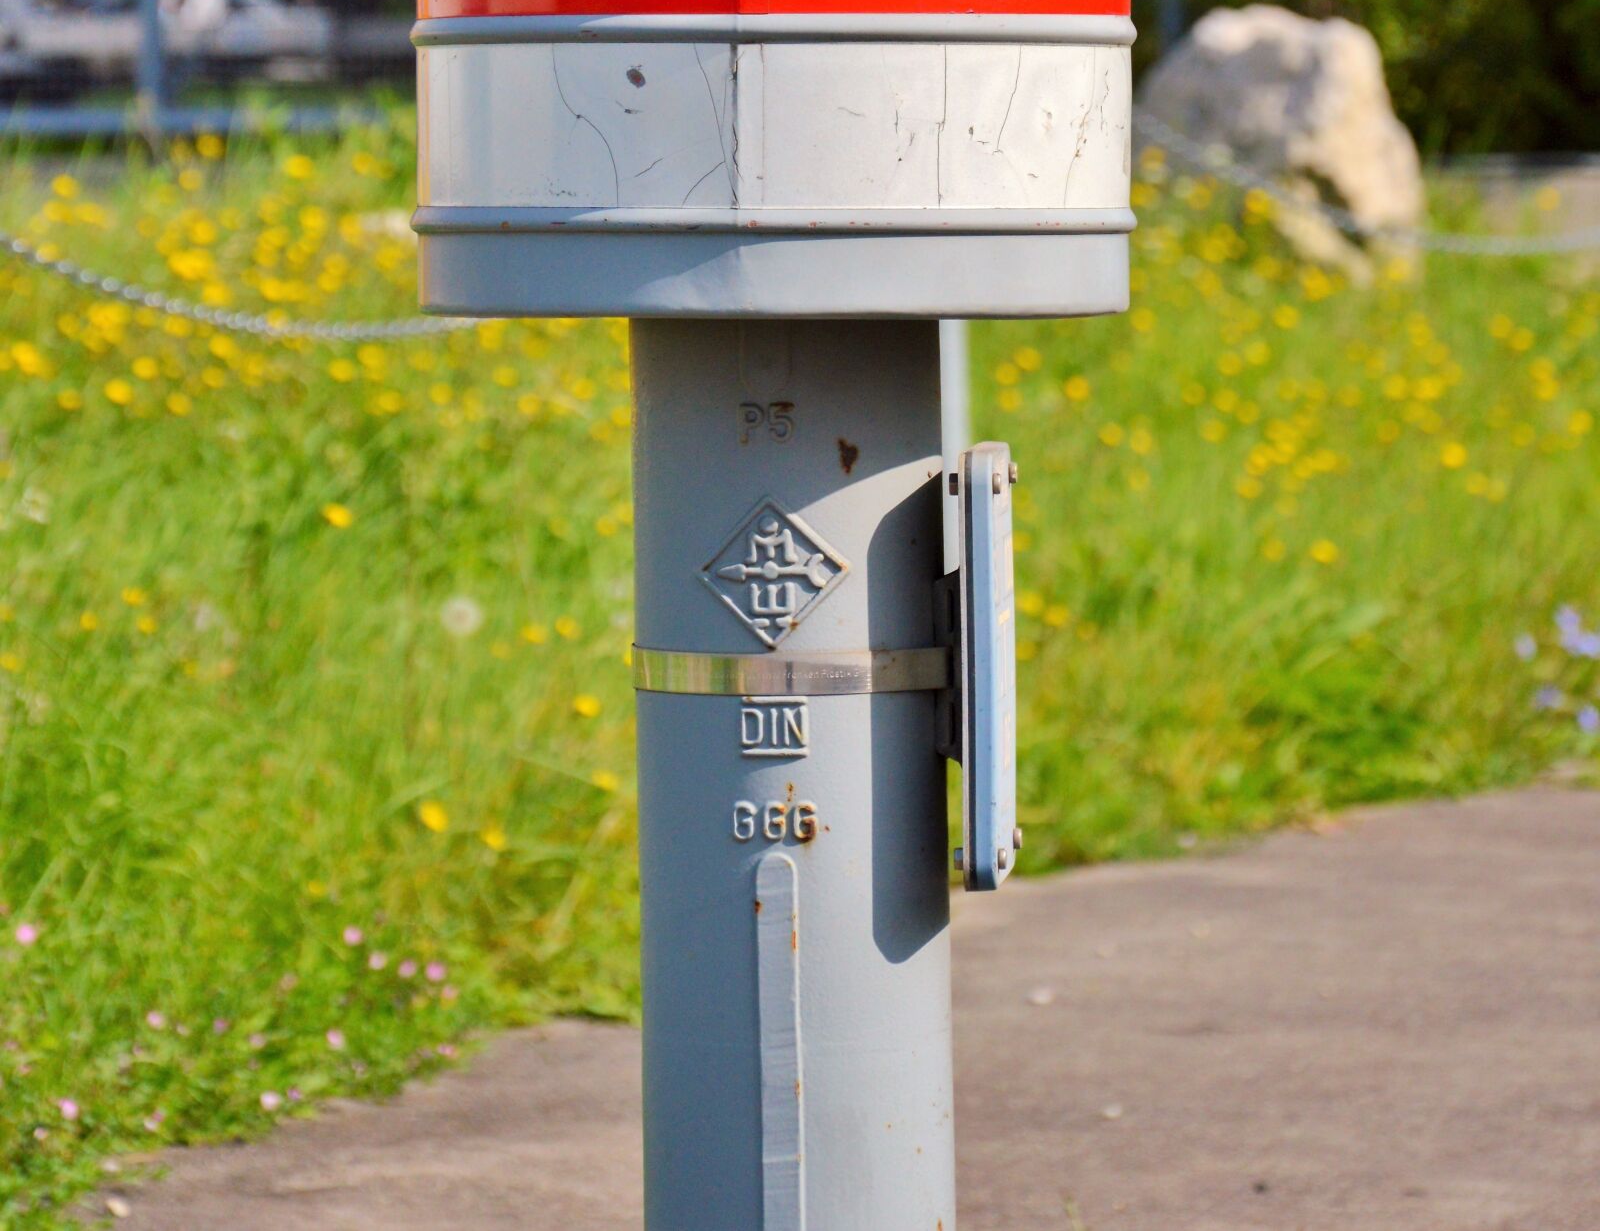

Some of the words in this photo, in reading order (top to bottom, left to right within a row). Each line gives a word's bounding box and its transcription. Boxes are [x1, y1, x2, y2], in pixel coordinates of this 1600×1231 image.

[737, 401, 796, 446] P5
[741, 706, 810, 746] DIN
[733, 801, 819, 842] GGG
